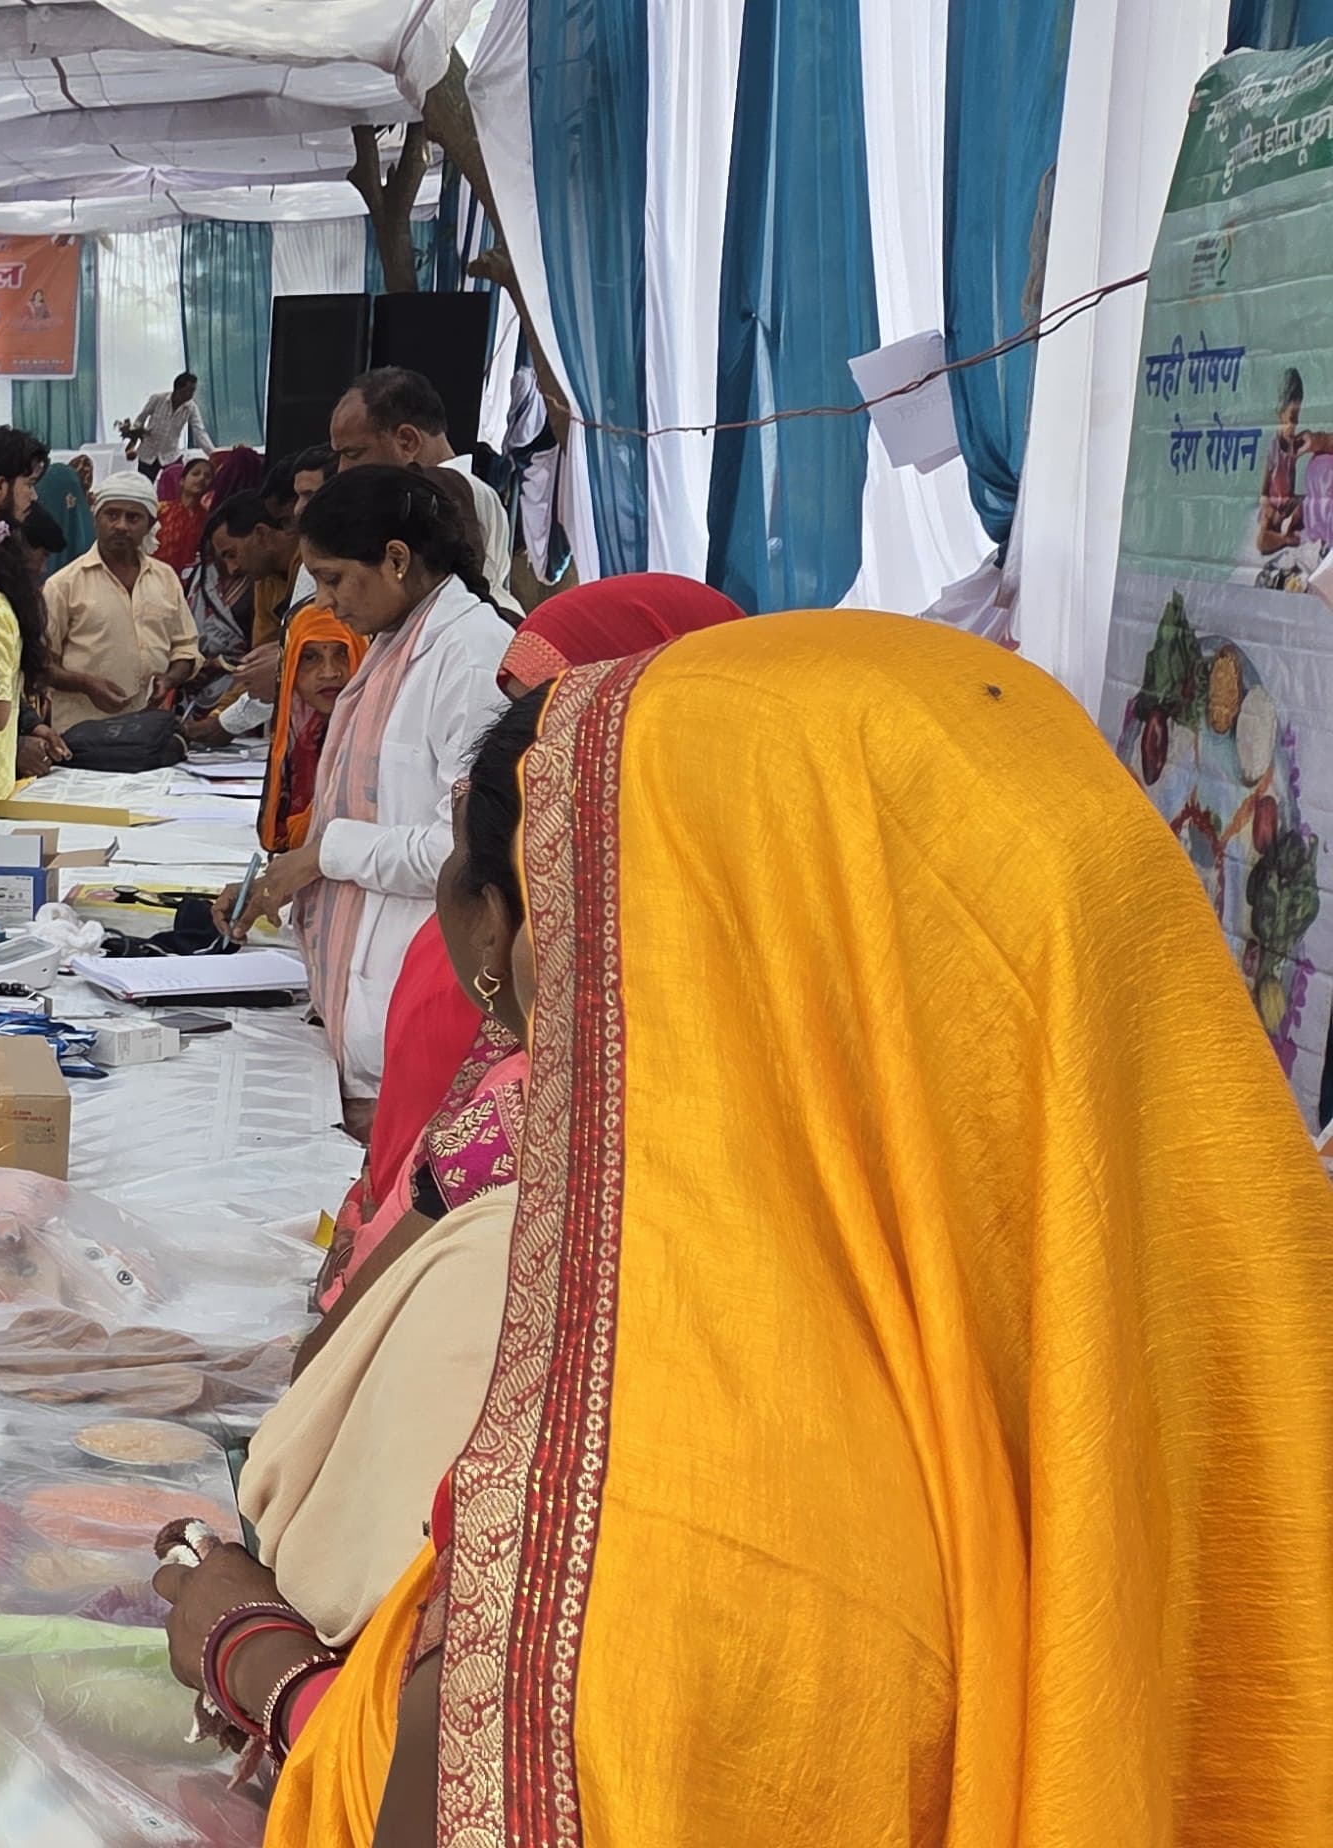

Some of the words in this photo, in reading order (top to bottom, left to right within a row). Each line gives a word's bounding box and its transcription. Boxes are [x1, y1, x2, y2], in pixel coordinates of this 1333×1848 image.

[1146, 334, 1185, 402] सही
[1188, 330, 1245, 394] पोषण
[1170, 412, 1203, 476] देश
[1206, 411, 1262, 474] रोशन
